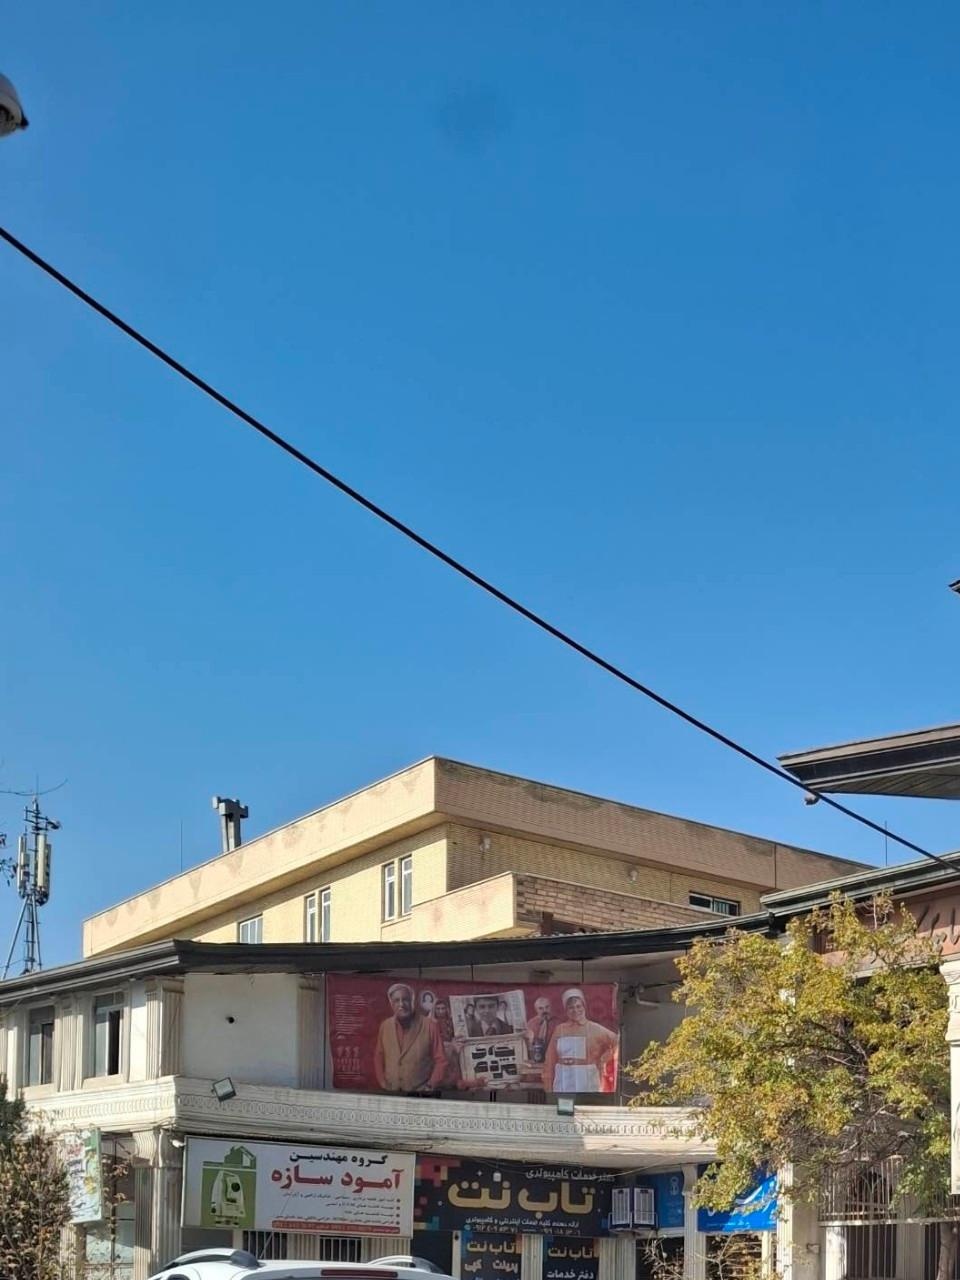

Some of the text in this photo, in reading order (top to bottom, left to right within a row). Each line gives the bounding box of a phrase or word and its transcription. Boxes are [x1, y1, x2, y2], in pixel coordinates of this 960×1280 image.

[289, 1151, 348, 1165] مهندسین
[271, 1165, 404, 1193] آمود سازه
[447, 1180, 596, 1219] تاب نت
[489, 1241, 515, 1255] تاب
[569, 1246, 593, 1261] تاب
[546, 1269, 576, 1279] خدمات
